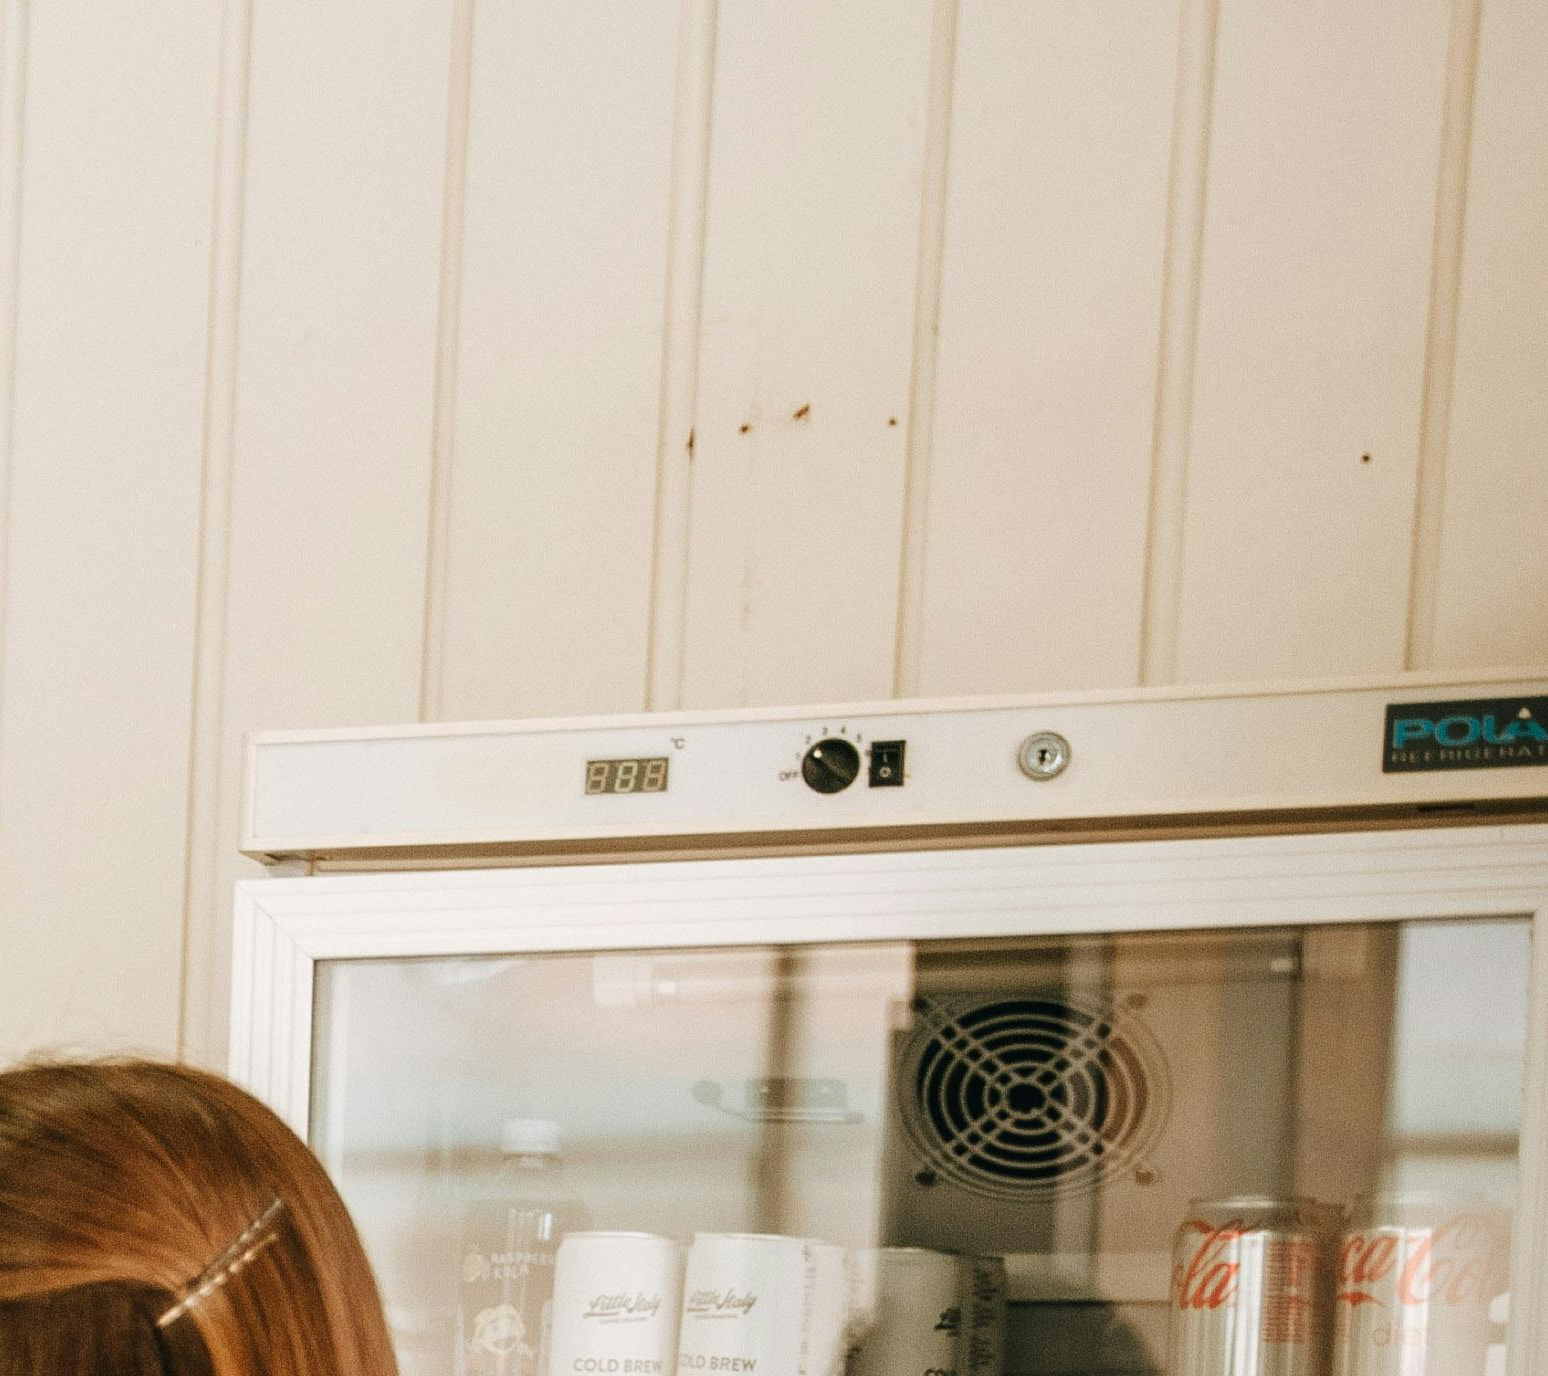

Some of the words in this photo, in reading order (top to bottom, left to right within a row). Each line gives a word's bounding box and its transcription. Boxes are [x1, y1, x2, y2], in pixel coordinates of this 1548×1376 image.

[778, 771, 799, 782] OFF
[572, 1357, 619, 1374] COLD
[623, 1359, 663, 1375] BREW
[710, 1355, 757, 1374] BREW
